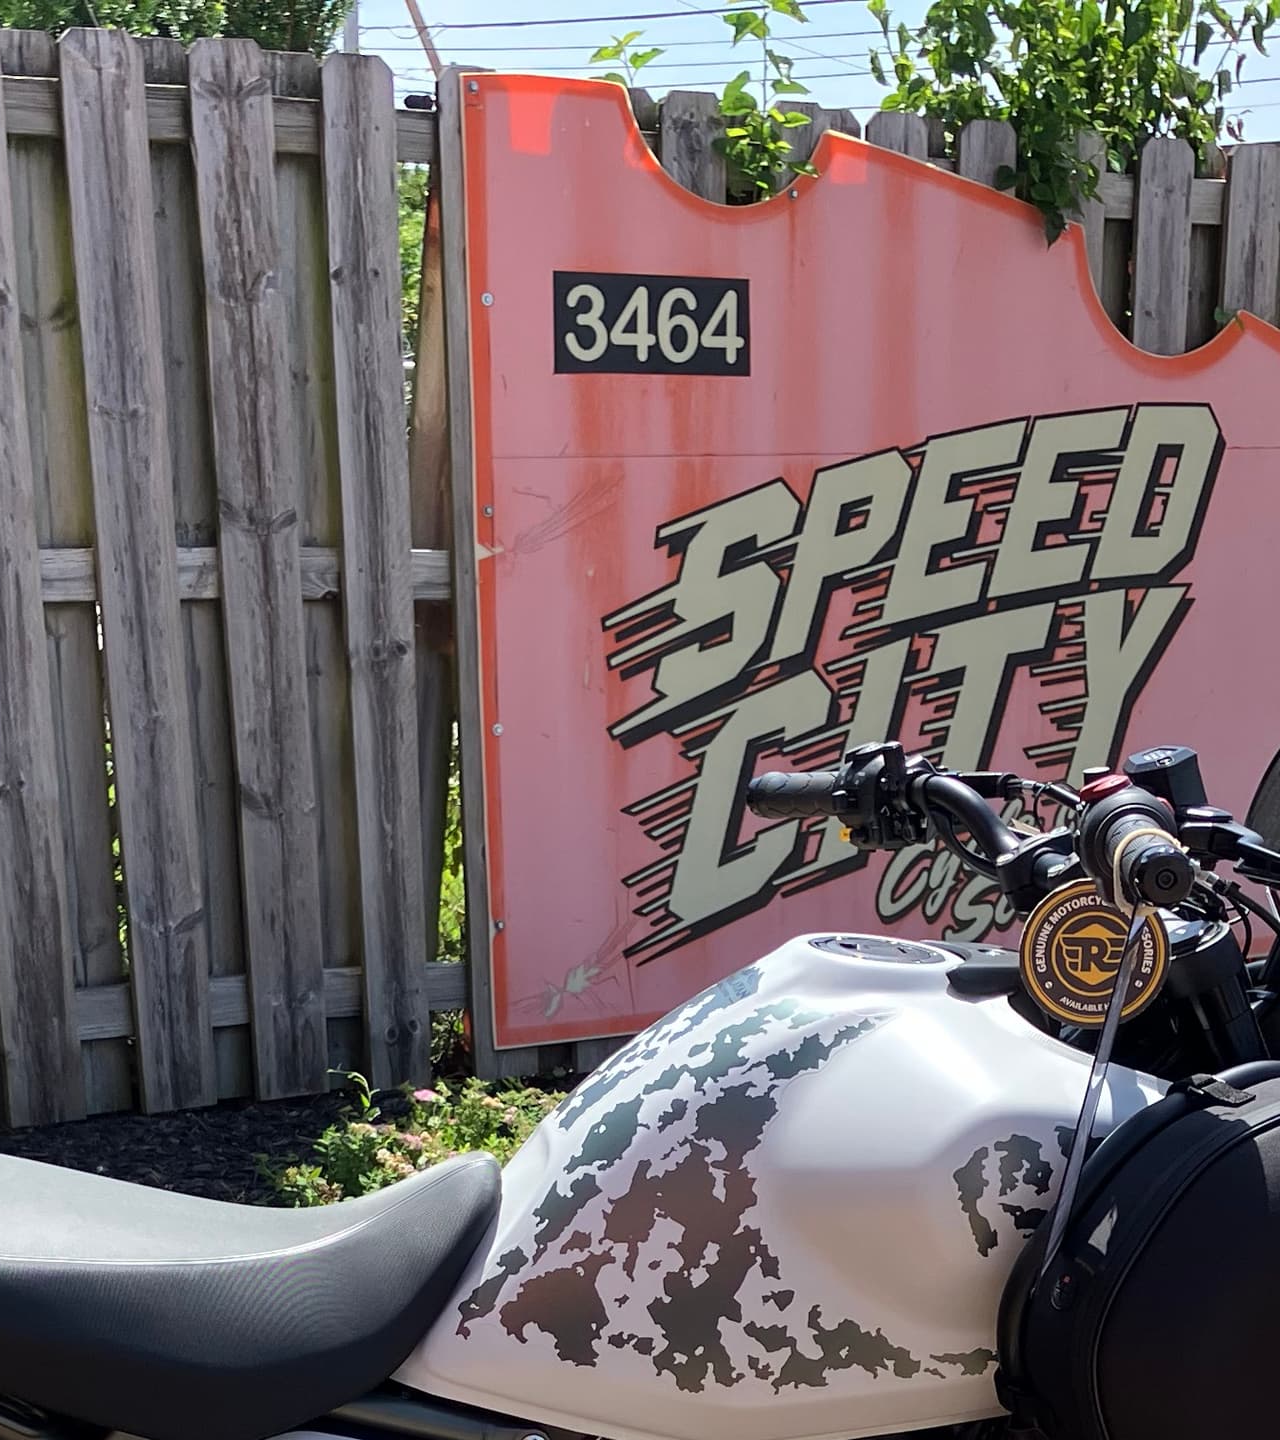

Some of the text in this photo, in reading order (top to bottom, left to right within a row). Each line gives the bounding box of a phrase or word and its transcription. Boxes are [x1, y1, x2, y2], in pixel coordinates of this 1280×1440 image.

[563, 284, 746, 366] 3464
[605, 402, 1227, 738] SPEED
[626, 584, 1194, 955] CITY
[1035, 921, 1054, 973] GENUINE
[1052, 895, 1112, 927] MOTORCY
[1060, 996, 1103, 1012] AVAILABLE
